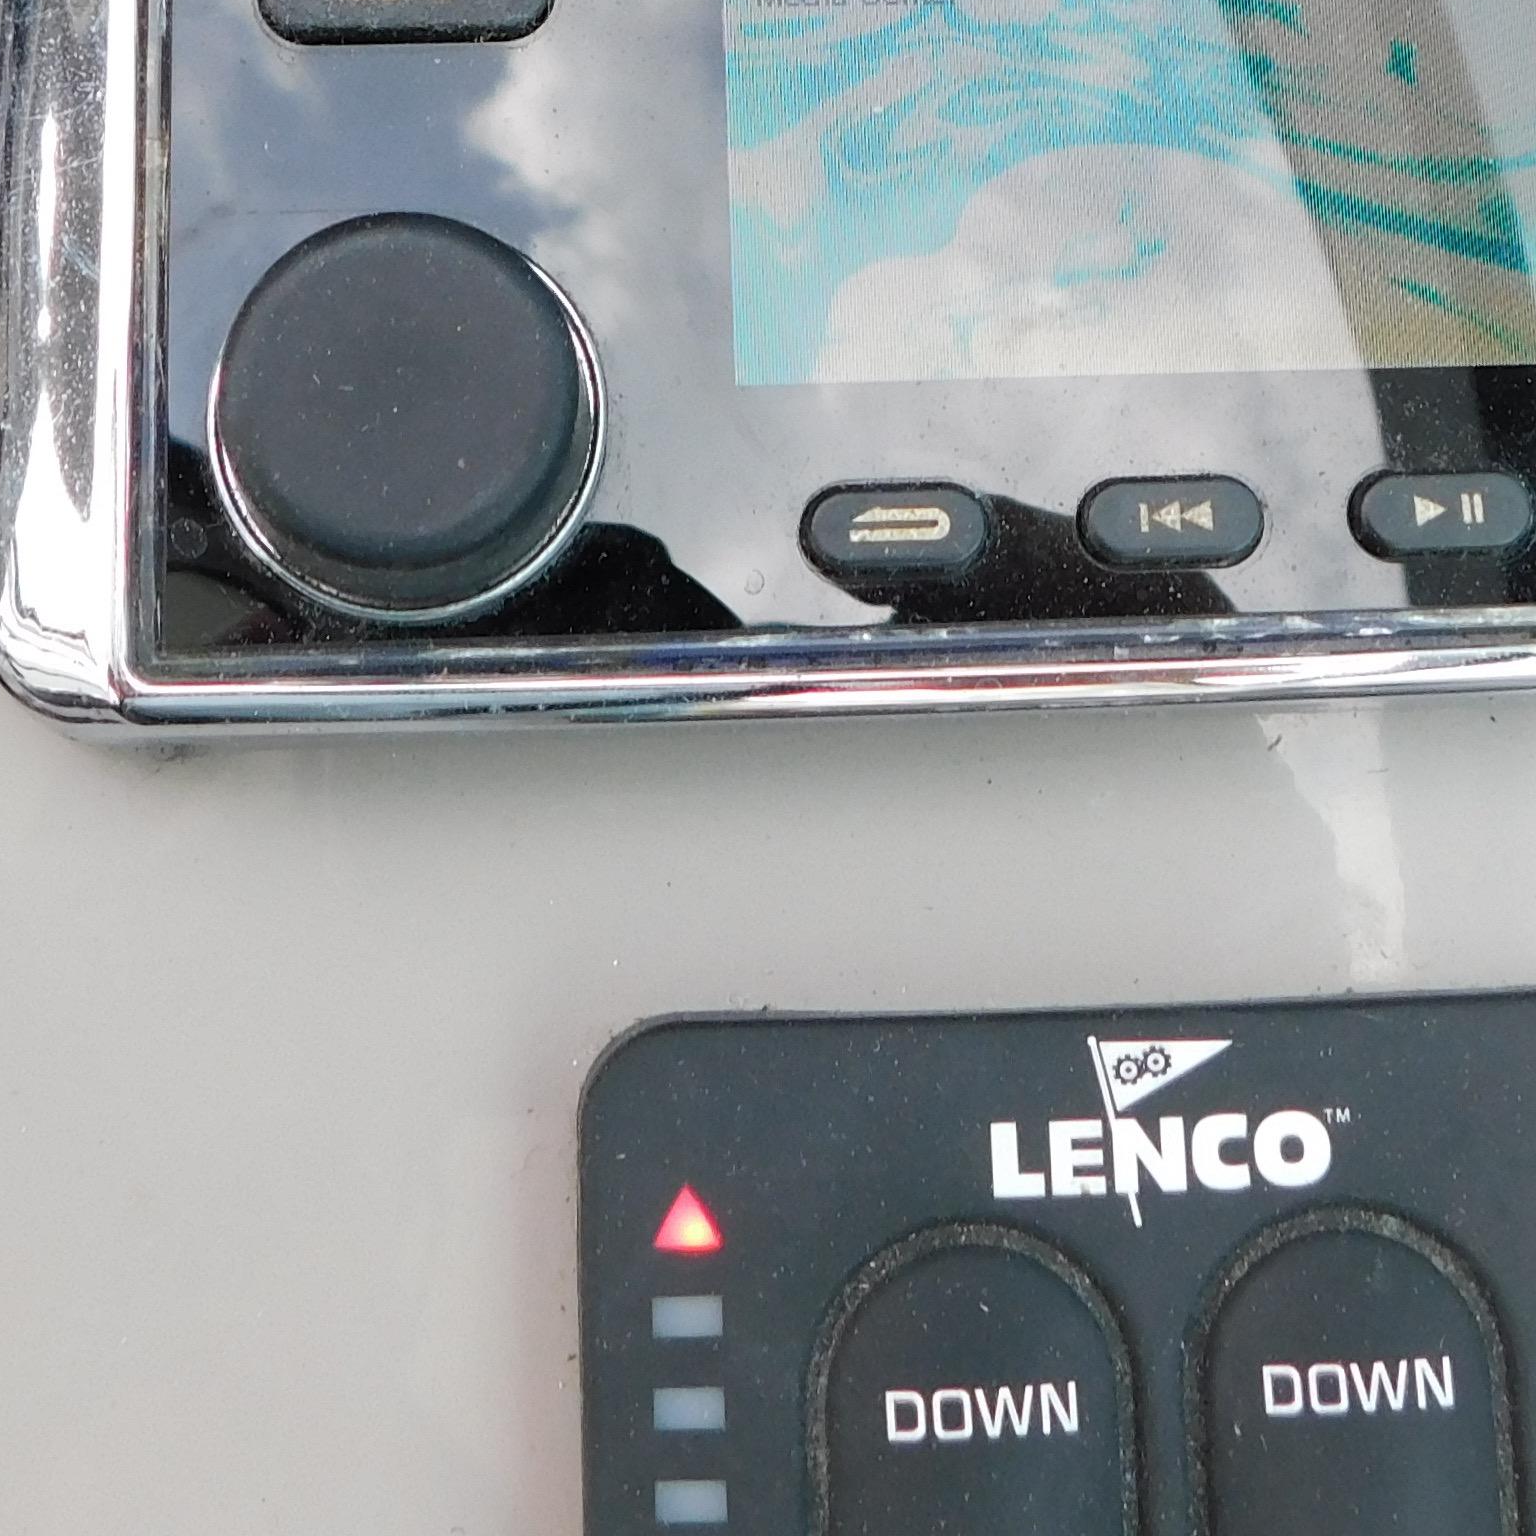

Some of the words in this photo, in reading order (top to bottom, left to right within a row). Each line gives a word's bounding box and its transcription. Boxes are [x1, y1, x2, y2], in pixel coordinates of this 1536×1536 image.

[990, 1110, 1332, 1199] LENCO
[884, 1381, 1079, 1443] DOWN
[1262, 1356, 1454, 1415] DOWN
